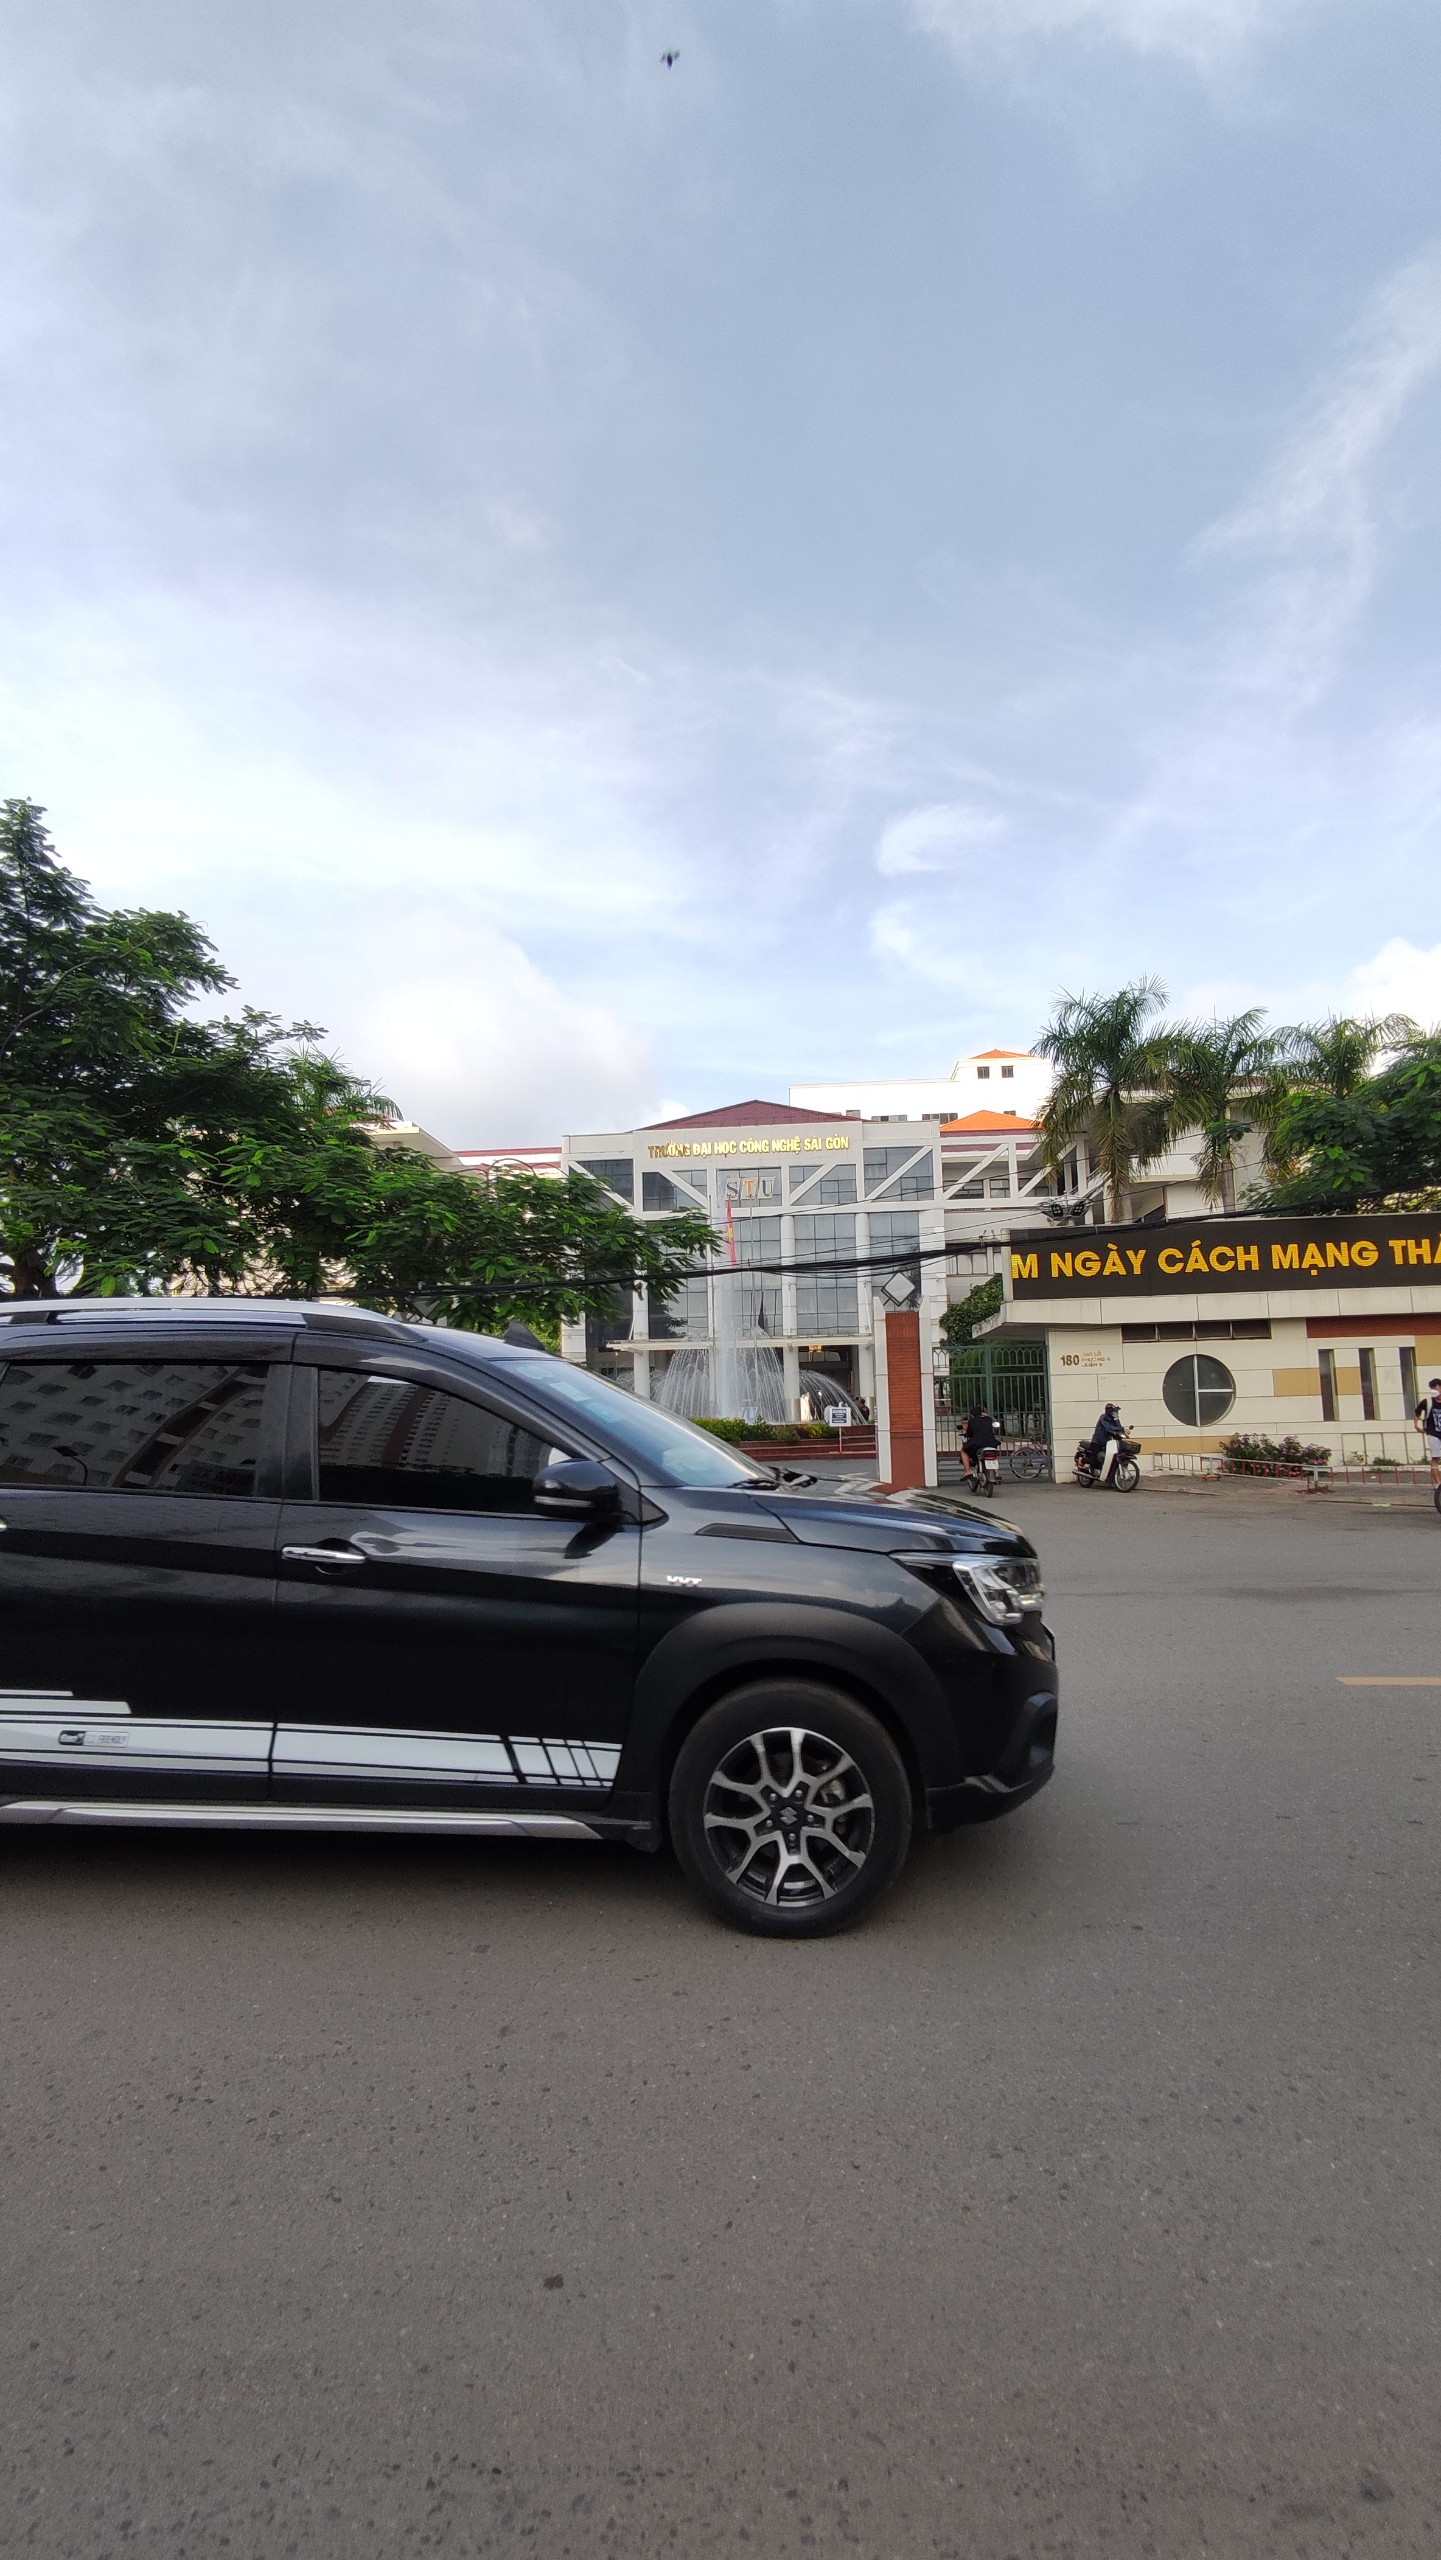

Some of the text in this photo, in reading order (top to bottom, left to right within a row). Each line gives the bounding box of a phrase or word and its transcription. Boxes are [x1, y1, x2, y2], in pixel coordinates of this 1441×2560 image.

[648, 1133, 850, 1159] TRƯỜNG ĐẠI HỌC CÔNG NGHỆ SÀI GÒN
[1051, 1242, 1147, 1278] NGÀY
[1157, 1239, 1260, 1275] CÁCH
[1270, 1240, 1380, 1276] MẠNG
[1060, 1354, 1080, 1367] 180
